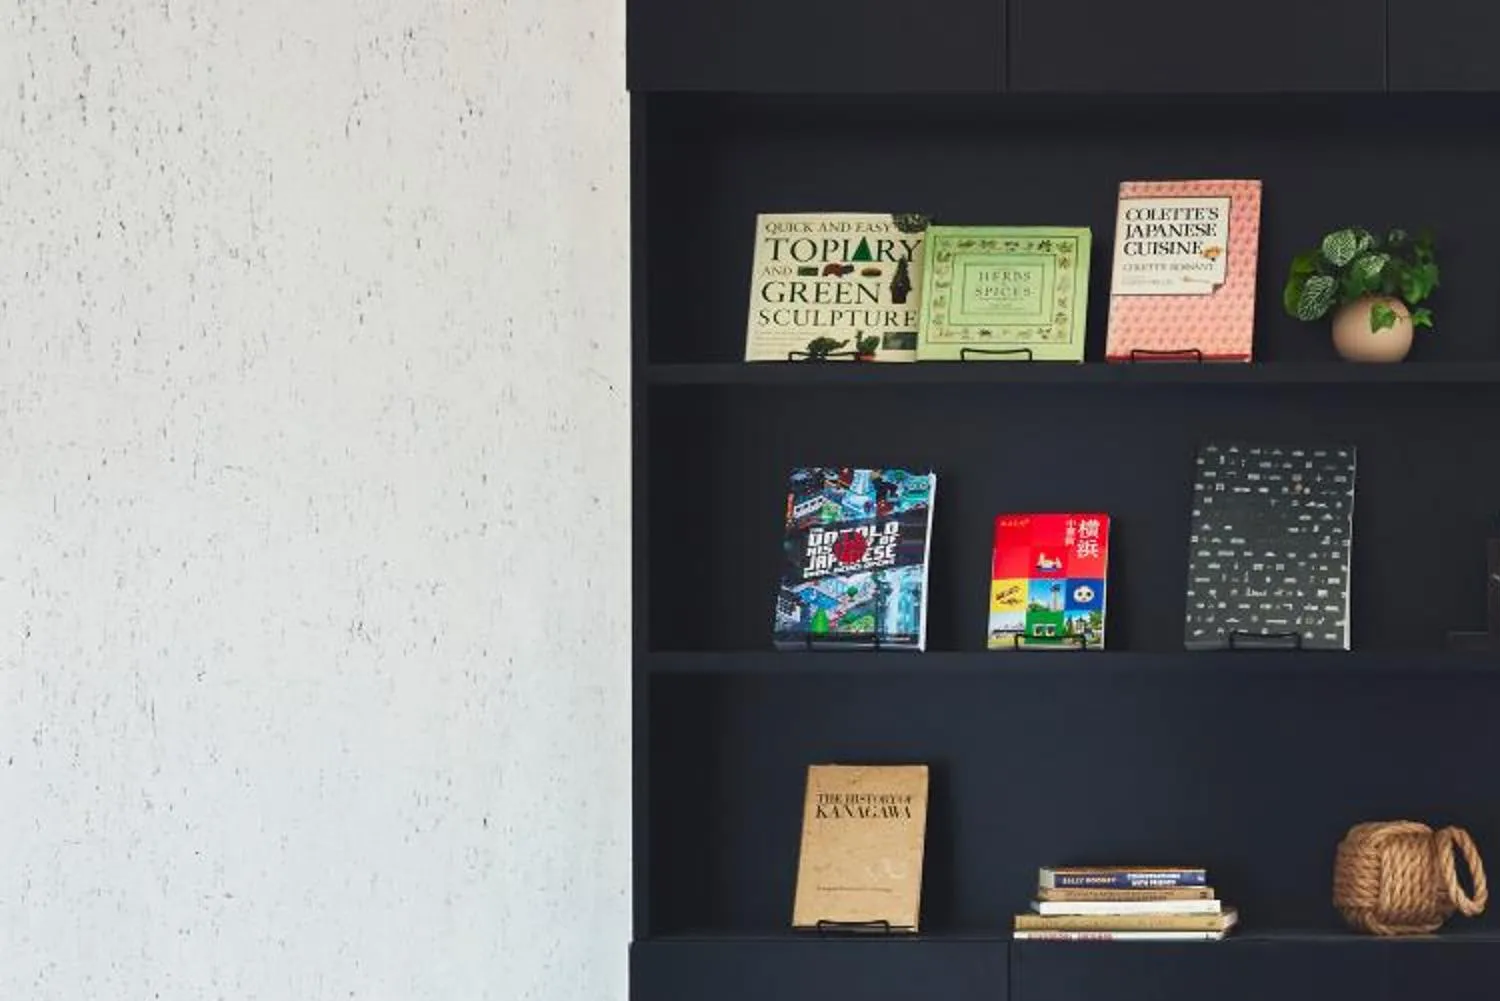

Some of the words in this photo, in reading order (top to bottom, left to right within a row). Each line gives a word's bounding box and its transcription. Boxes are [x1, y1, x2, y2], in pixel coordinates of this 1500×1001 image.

[1125, 207, 1218, 221] COLETTE'S
[764, 221, 813, 234] QUICK
[818, 220, 851, 233] AND
[853, 221, 891, 233] EASY
[1124, 223, 1216, 240] JAPANESE
[1123, 241, 1203, 256] CUISINE
[761, 266, 793, 276] AND
[761, 281, 880, 304] GREEN
[758, 308, 918, 327] SCULPTURE
[804, 544, 897, 571] JAPESE
[815, 804, 911, 819] KANAGAWA
